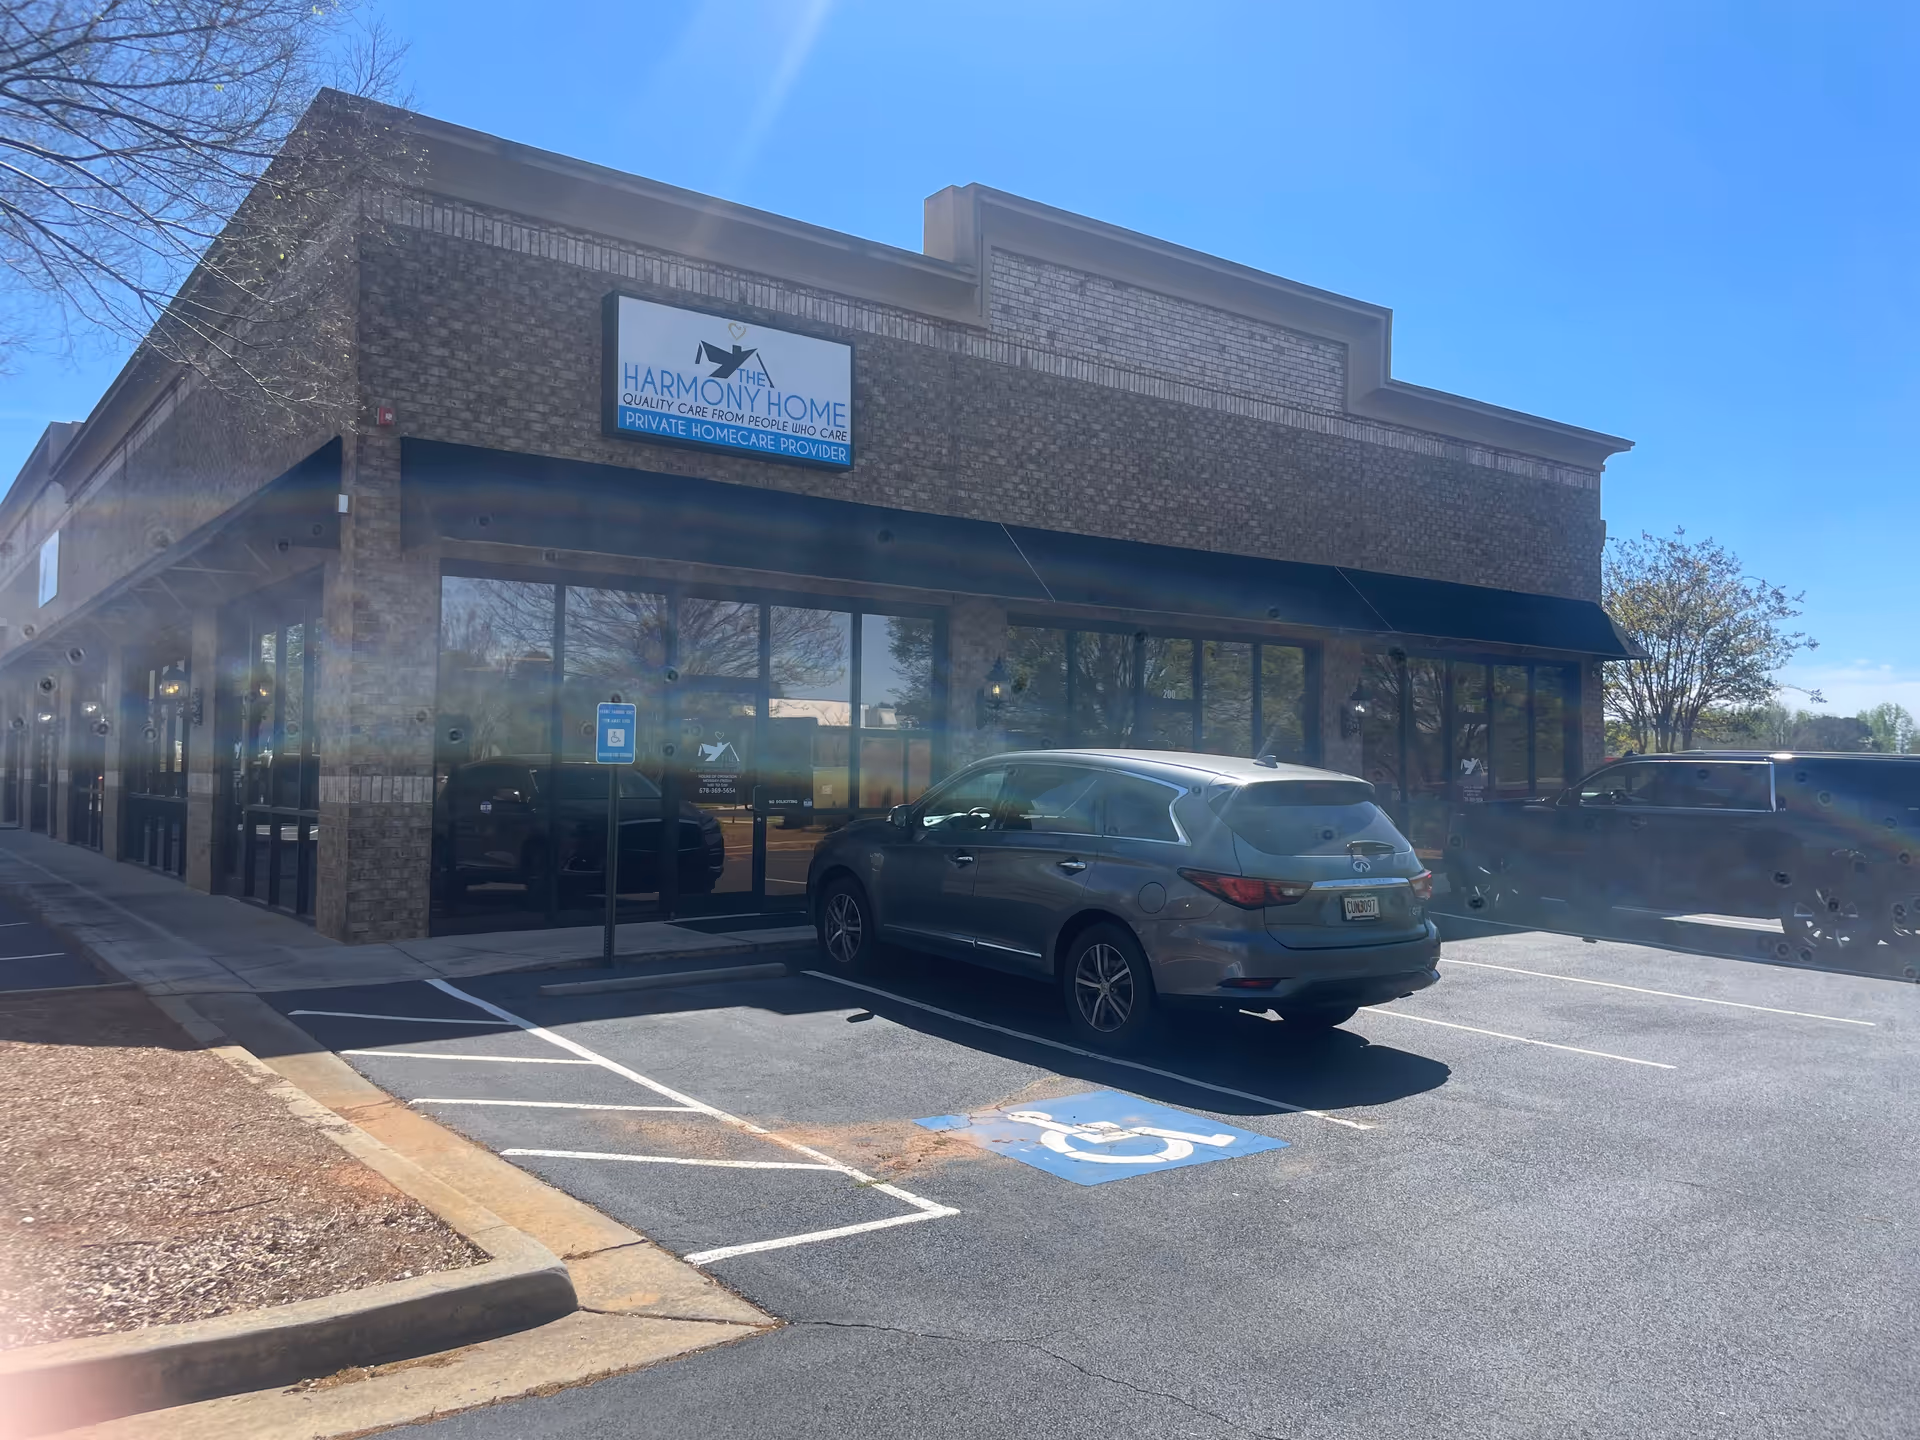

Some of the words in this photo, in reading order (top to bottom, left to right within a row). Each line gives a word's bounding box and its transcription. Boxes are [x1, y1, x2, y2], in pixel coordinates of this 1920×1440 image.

[624, 362, 761, 413] HARMONY
[767, 390, 846, 429] HOME
[736, 368, 766, 387] THE
[623, 392, 674, 412] QUALITY
[677, 402, 708, 418] CARE
[711, 408, 744, 424] FROM
[748, 415, 788, 432] PEOPLE
[791, 422, 816, 436] WHO
[820, 428, 848, 441] CARE
[626, 411, 686, 435] PRIVATE
[692, 422, 775, 450] HOMECARE
[780, 437, 846, 461] PROVIDER
[1163, 689, 1176, 699] 200
